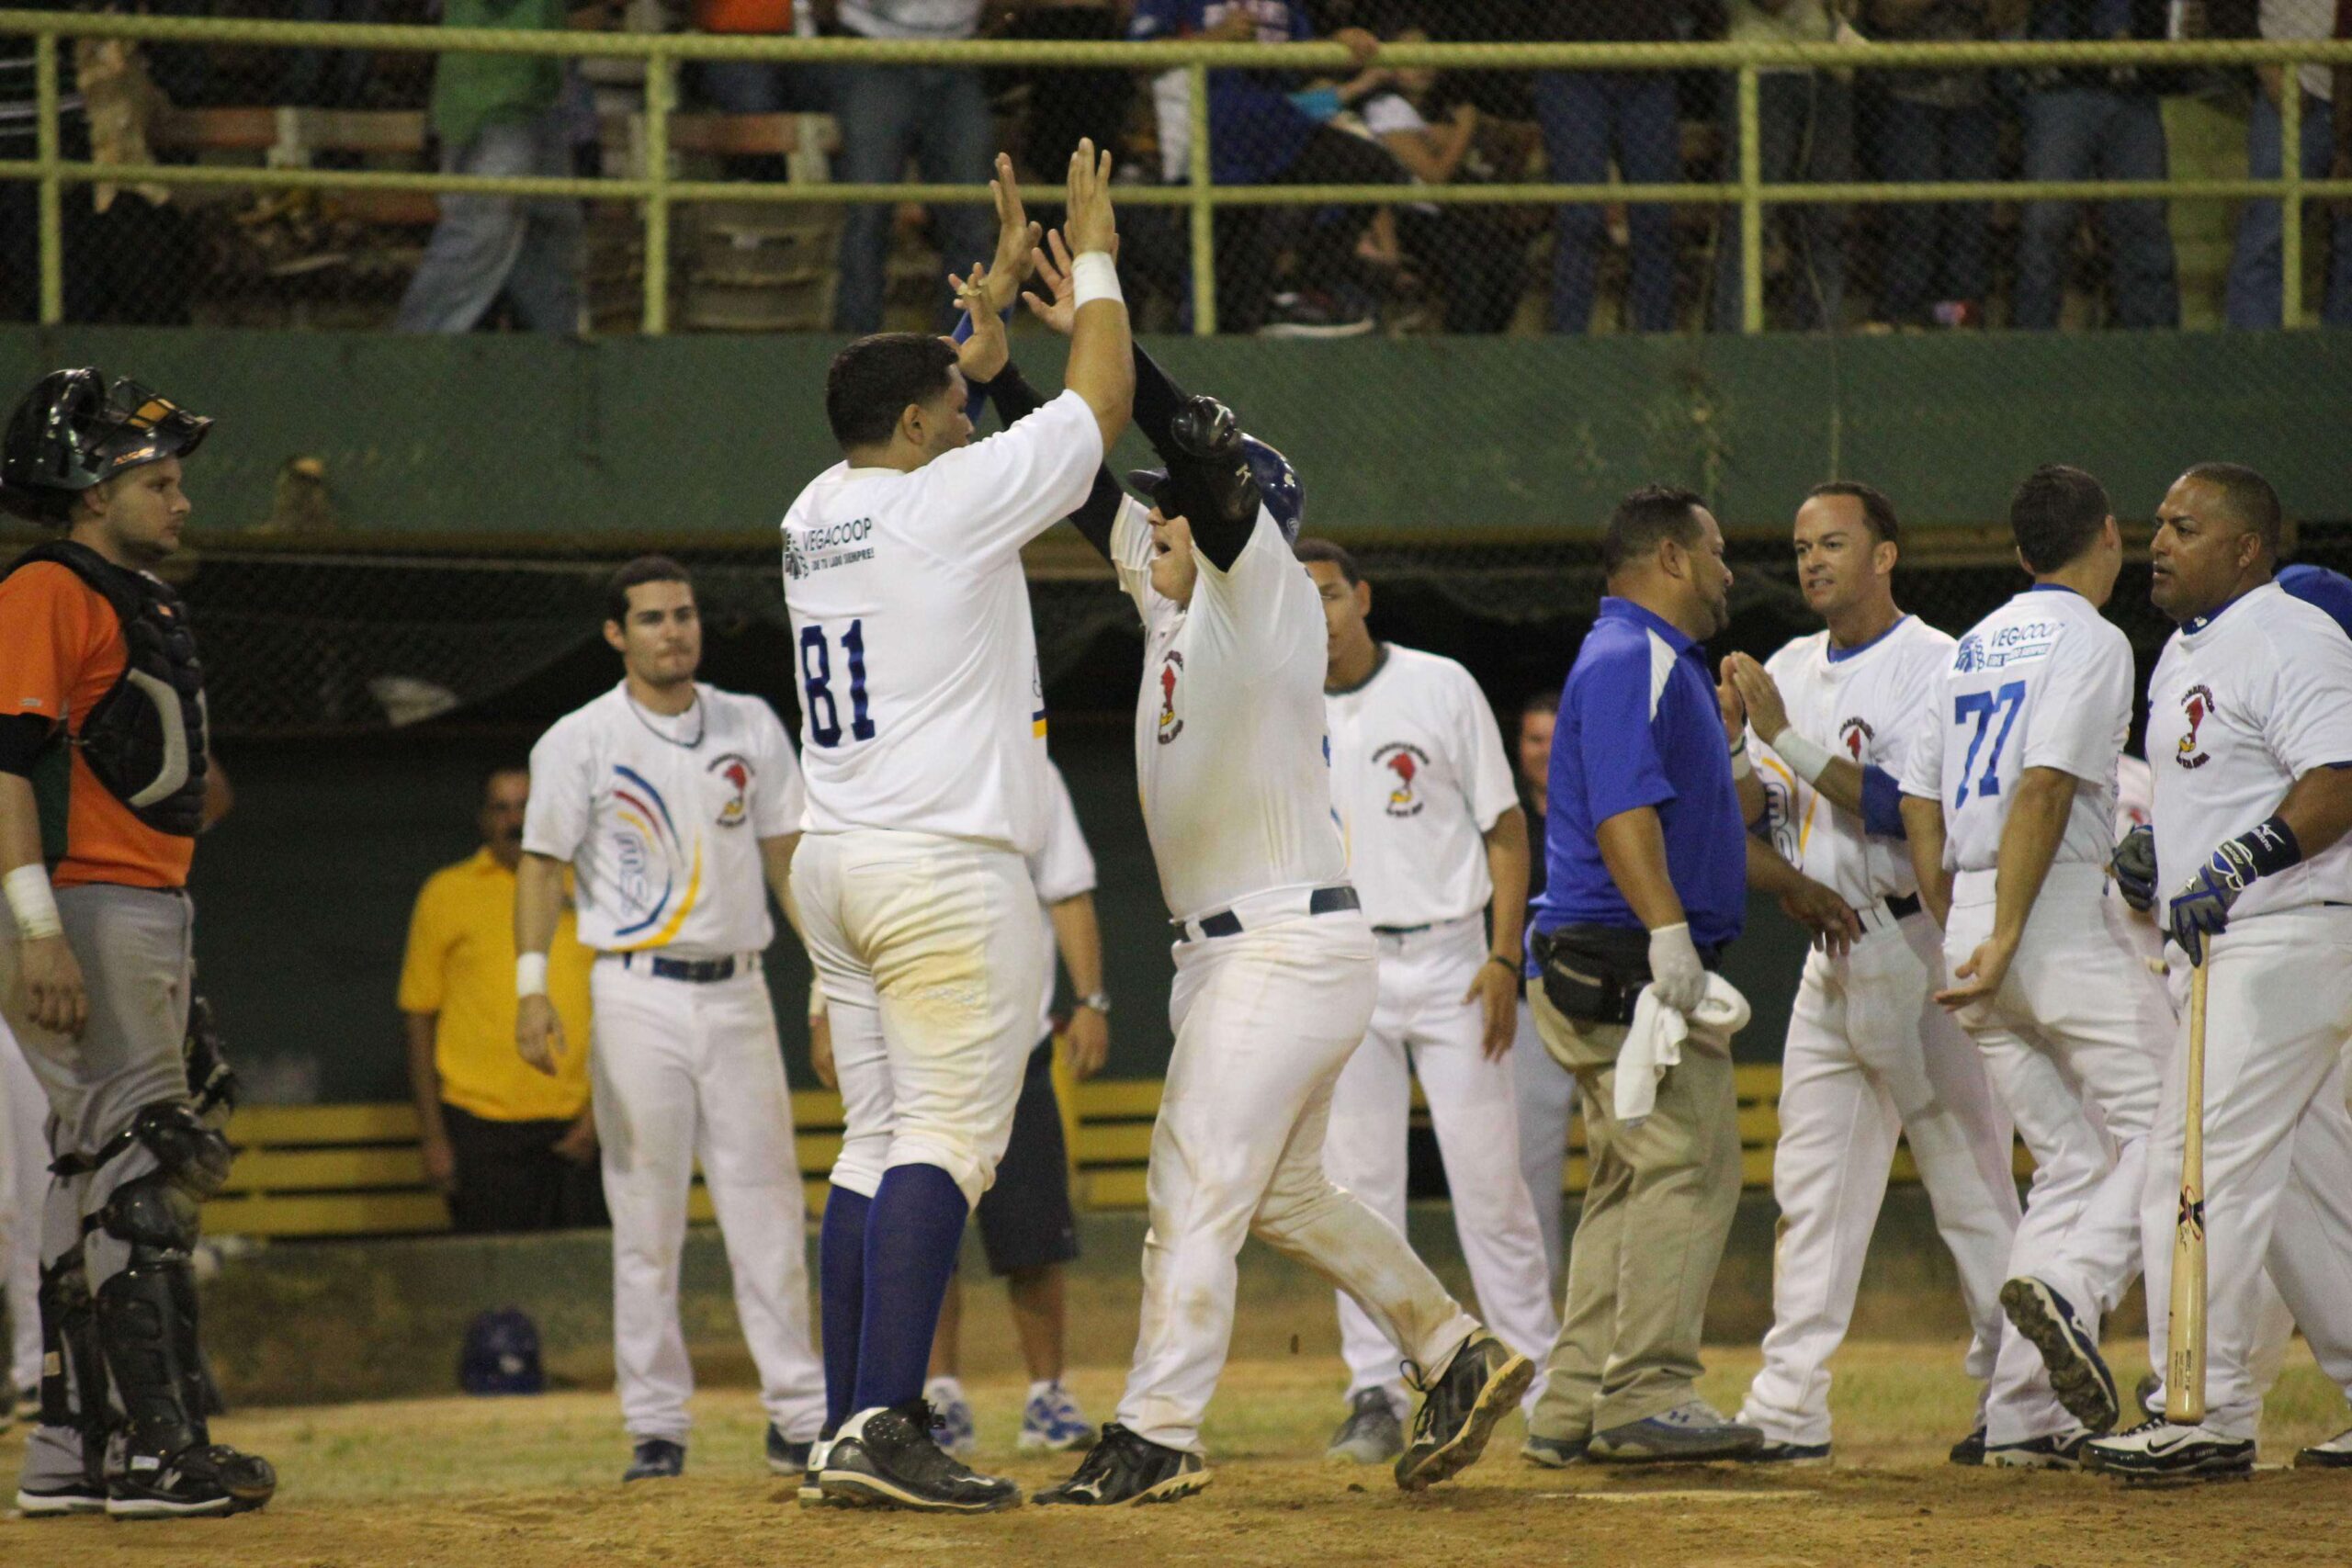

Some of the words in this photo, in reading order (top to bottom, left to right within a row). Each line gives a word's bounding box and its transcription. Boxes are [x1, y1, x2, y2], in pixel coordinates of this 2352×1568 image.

[802, 517, 872, 551] VEGACOOP
[843, 547, 875, 564] SIEMPRE!
[800, 618, 876, 749] 81
[1954, 680, 2026, 809] 77
